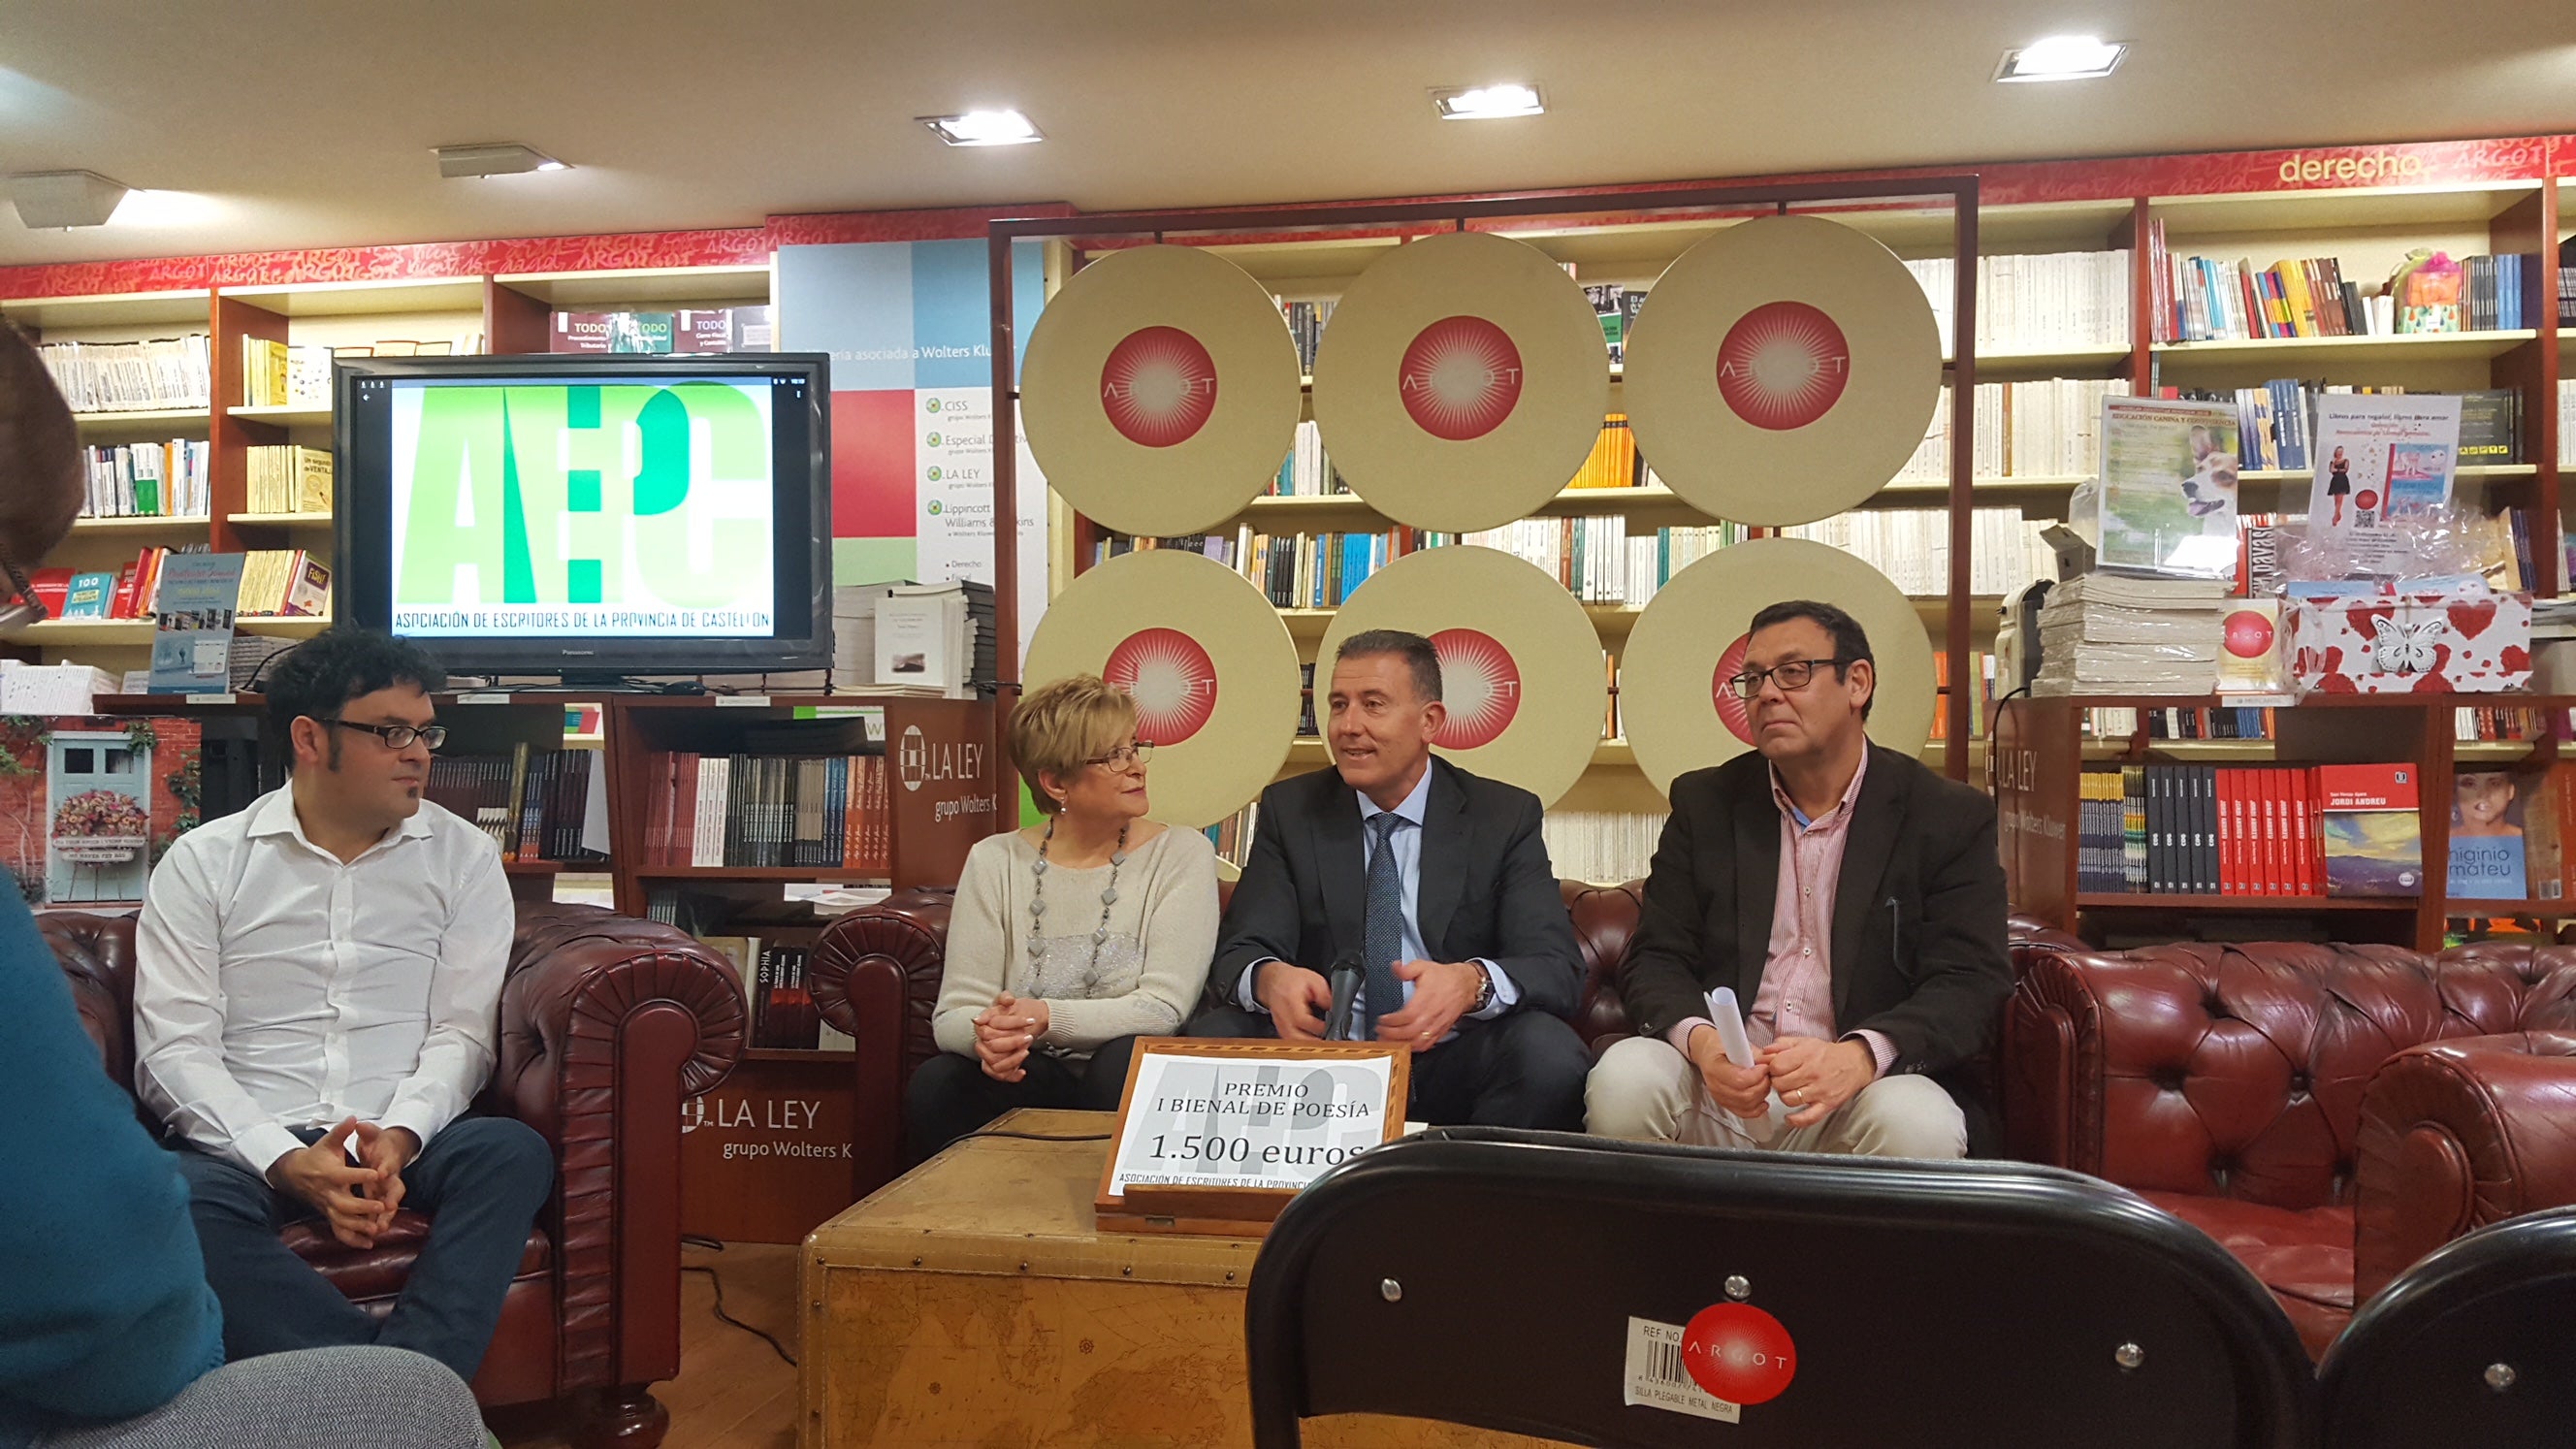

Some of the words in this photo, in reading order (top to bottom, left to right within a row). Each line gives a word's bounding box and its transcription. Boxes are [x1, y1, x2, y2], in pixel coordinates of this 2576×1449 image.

[2279, 150, 2423, 182] derecho
[574, 323, 606, 333] TODO
[696, 320, 725, 330] TODO
[855, 348, 908, 361] asociada
[912, 350, 918, 359] a
[921, 346, 969, 359] Wolters
[945, 401, 968, 411] CISS
[946, 435, 985, 447] Especial
[946, 469, 959, 479] LA
[962, 468, 981, 479] LEY
[945, 504, 990, 517] Lippincott
[945, 518, 986, 528] Williams
[79, 577, 99, 588] 100
[473, 612, 488, 628] DE
[494, 612, 568, 628] ESCRITORES
[574, 612, 588, 628] DE
[594, 612, 607, 628] LA
[612, 612, 677, 628] PROVINCIA
[682, 612, 696, 628] DE
[933, 743, 952, 780] LA
[958, 743, 983, 779] LEY
[2003, 750, 2015, 789] LA
[2018, 750, 2038, 792] LEY
[935, 799, 959, 822] grupo
[960, 794, 990, 814] Wolters
[2355, 797, 2386, 806] ANDREU
[758, 950, 772, 983] SOPHIA
[1224, 1083, 1309, 1098] PREMIO
[719, 1099, 756, 1127] LA
[767, 1099, 821, 1129] LEY
[1157, 1098, 1164, 1111] I
[1171, 1099, 1250, 1115] BIENAL
[1257, 1102, 1286, 1115] DE
[1292, 1100, 1369, 1118] POESÍA
[723, 1142, 769, 1160] grupo
[773, 1141, 836, 1158] Wolters
[1148, 1135, 1250, 1163] 1.500
[1186, 1176, 1239, 1187] ESCRITORES
[1643, 1325, 1661, 1338] REF
[1635, 1385, 1652, 1398] SILLA
[1655, 1390, 1686, 1404] PLEGABLE
[1689, 1397, 1707, 1410] METAL
[1711, 1401, 1733, 1414] NEGRA
